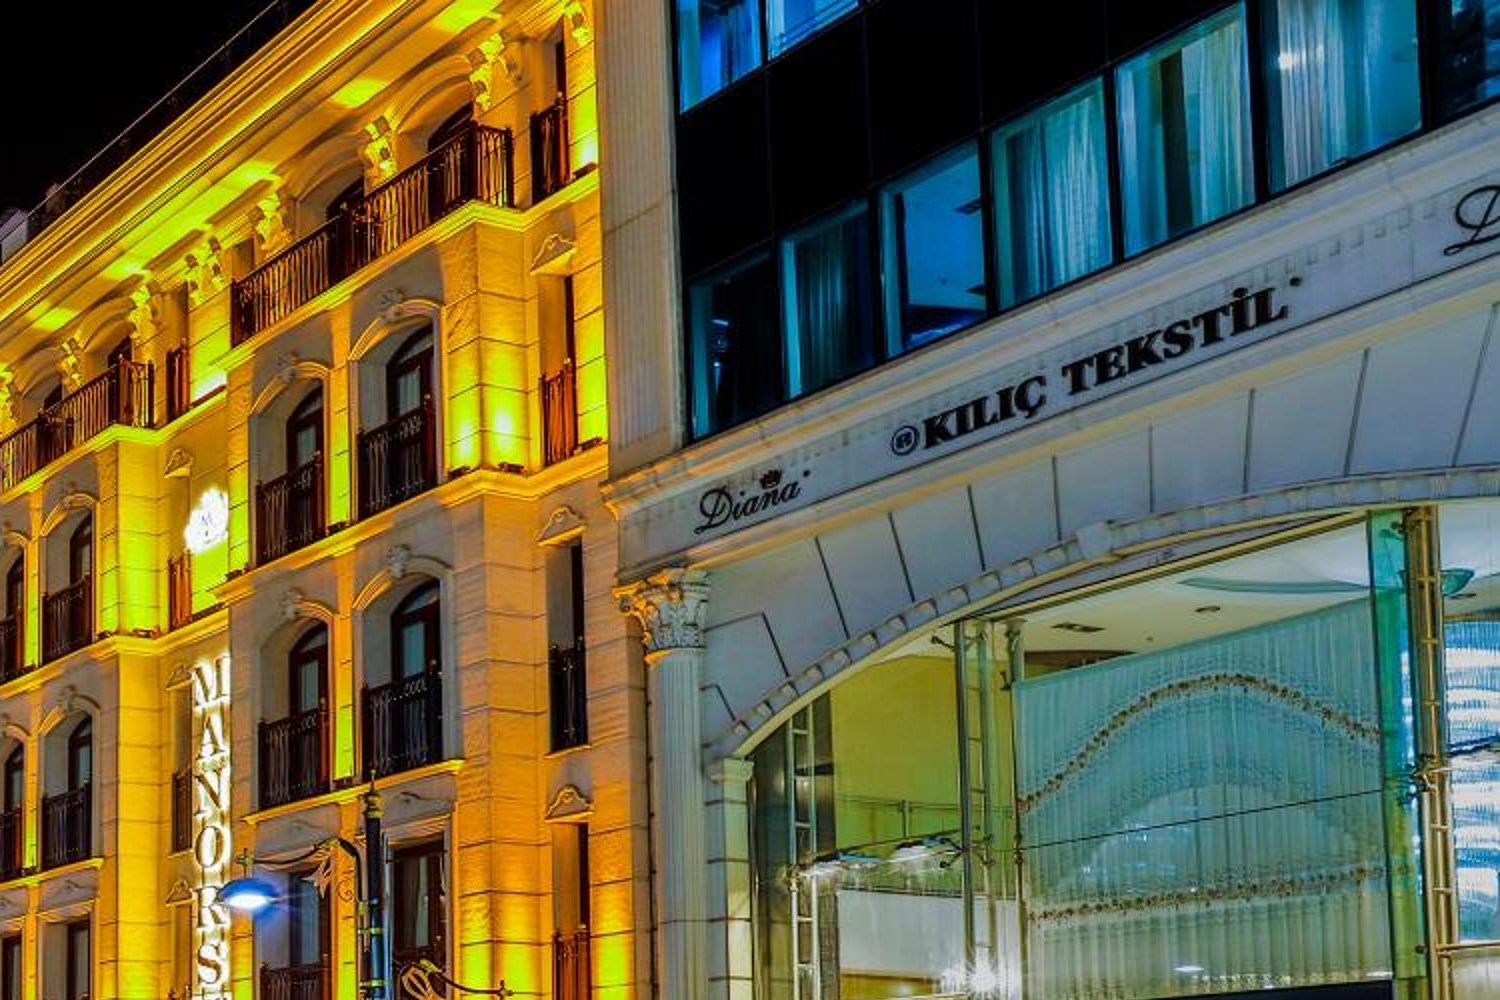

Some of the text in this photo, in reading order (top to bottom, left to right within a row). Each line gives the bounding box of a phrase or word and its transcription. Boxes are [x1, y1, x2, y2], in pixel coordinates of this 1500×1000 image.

[922, 287, 1290, 450] KILIÇ TEKSTİL
[694, 480, 802, 534] Diana
[192, 655, 231, 986] MANORS
